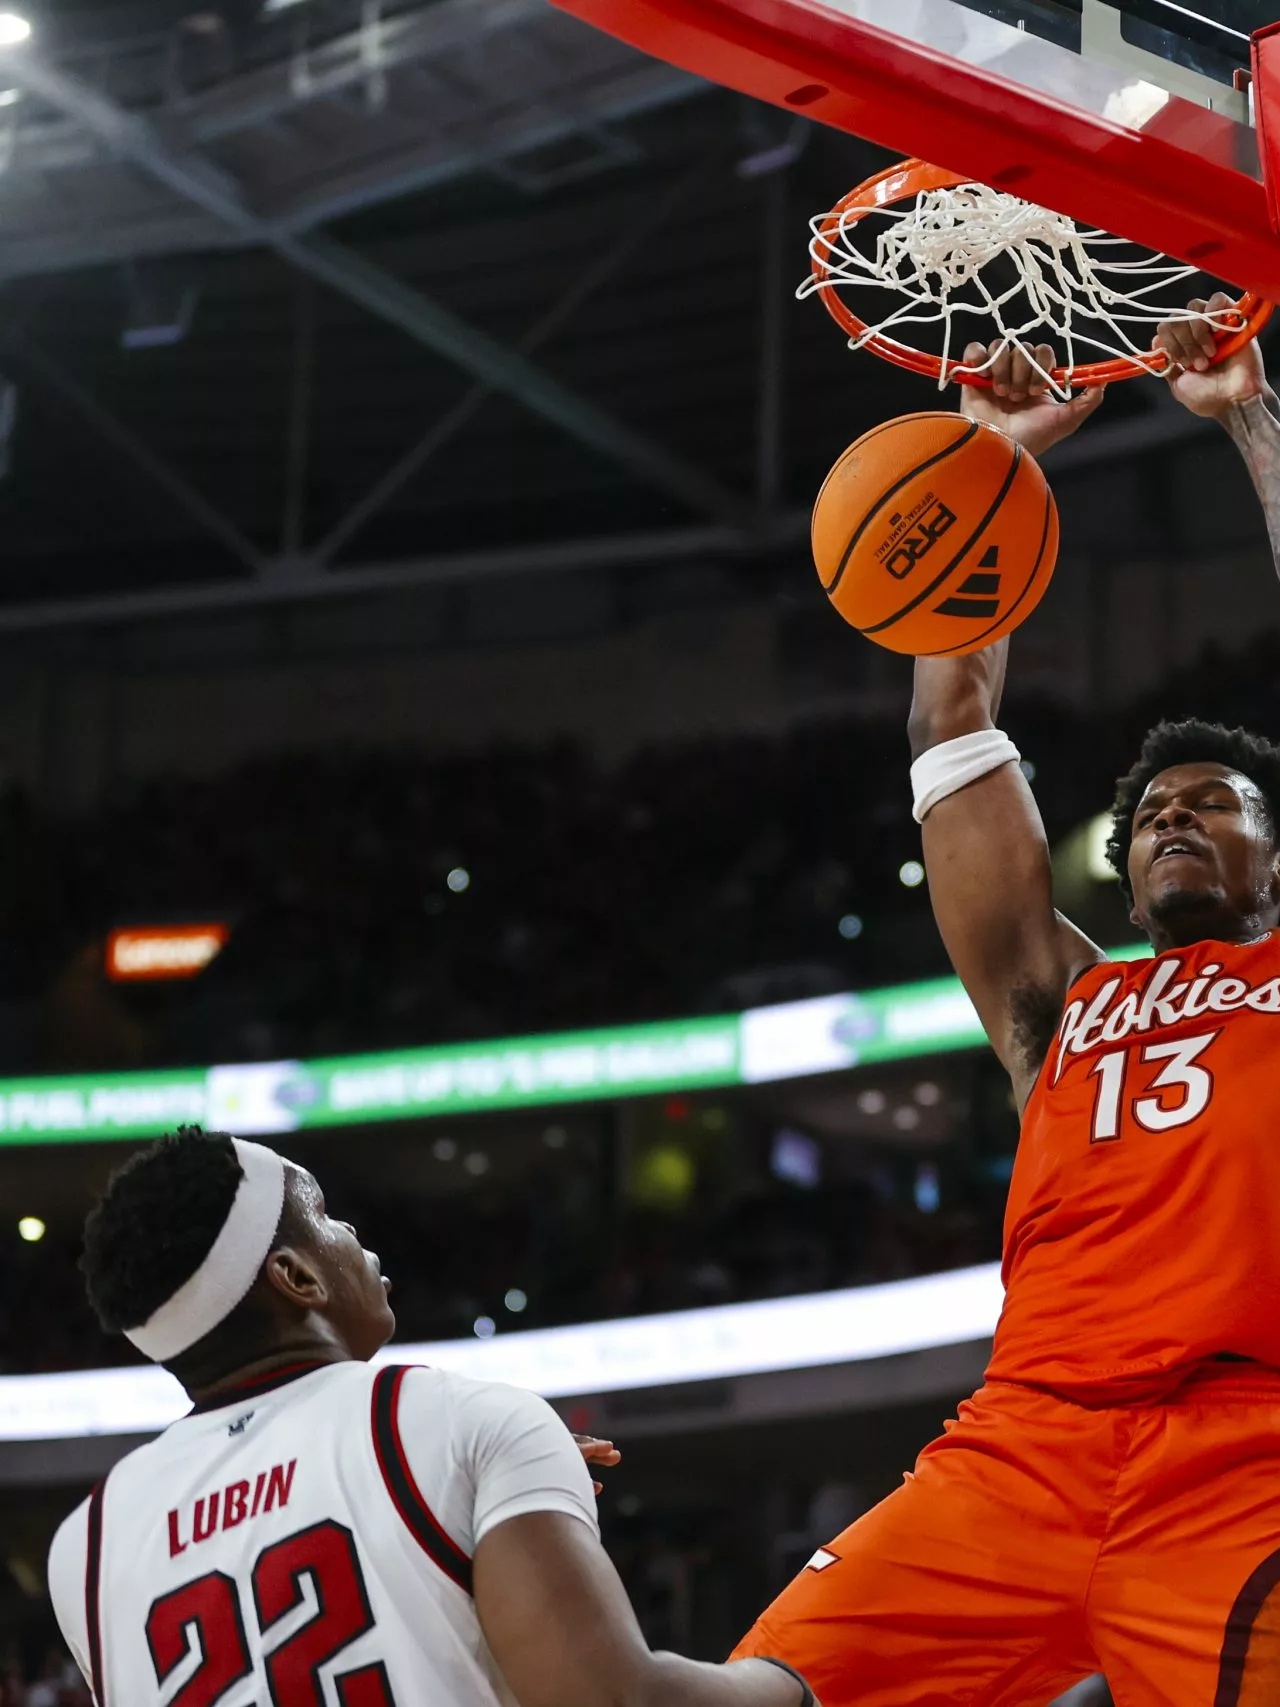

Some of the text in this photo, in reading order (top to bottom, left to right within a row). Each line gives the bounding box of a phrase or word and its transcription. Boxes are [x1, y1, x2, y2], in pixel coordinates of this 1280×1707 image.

[886, 501, 957, 580] PRO
[904, 491, 935, 522] OFFICIAL
[1086, 1026, 1223, 1144] 13
[167, 1459, 298, 1559] LUBIN
[144, 1518, 396, 1707] 22
